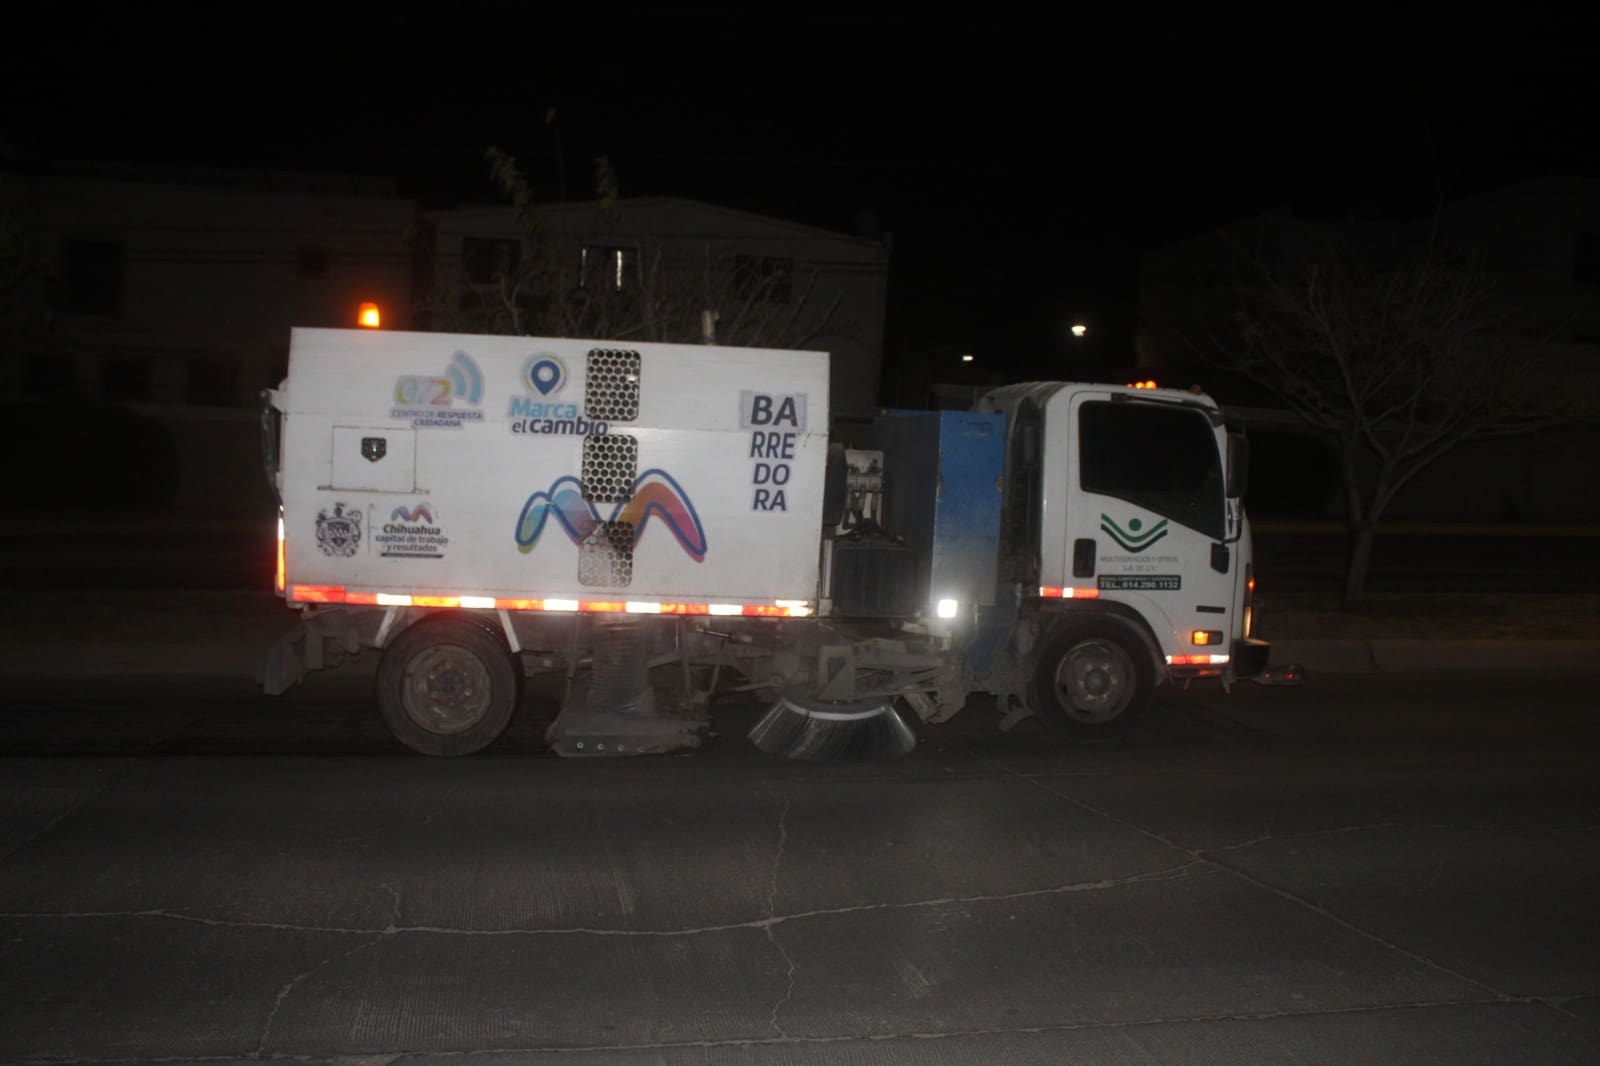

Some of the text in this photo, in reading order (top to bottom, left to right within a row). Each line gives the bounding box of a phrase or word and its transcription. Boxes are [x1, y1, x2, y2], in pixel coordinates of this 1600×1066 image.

[391, 408, 482, 420] CENTRO DE RESPUESTA
[509, 398, 578, 419] Marca
[750, 395, 798, 428] BA
[414, 418, 461, 427] CIUDADANA
[512, 416, 608, 436] el cambio
[750, 431, 796, 459] RRE
[753, 463, 790, 486] DO
[753, 489, 787, 511] RA
[383, 523, 441, 535] Chihuahua
[375, 534, 448, 545] capital de trabajo
[392, 544, 437, 553] resultados
